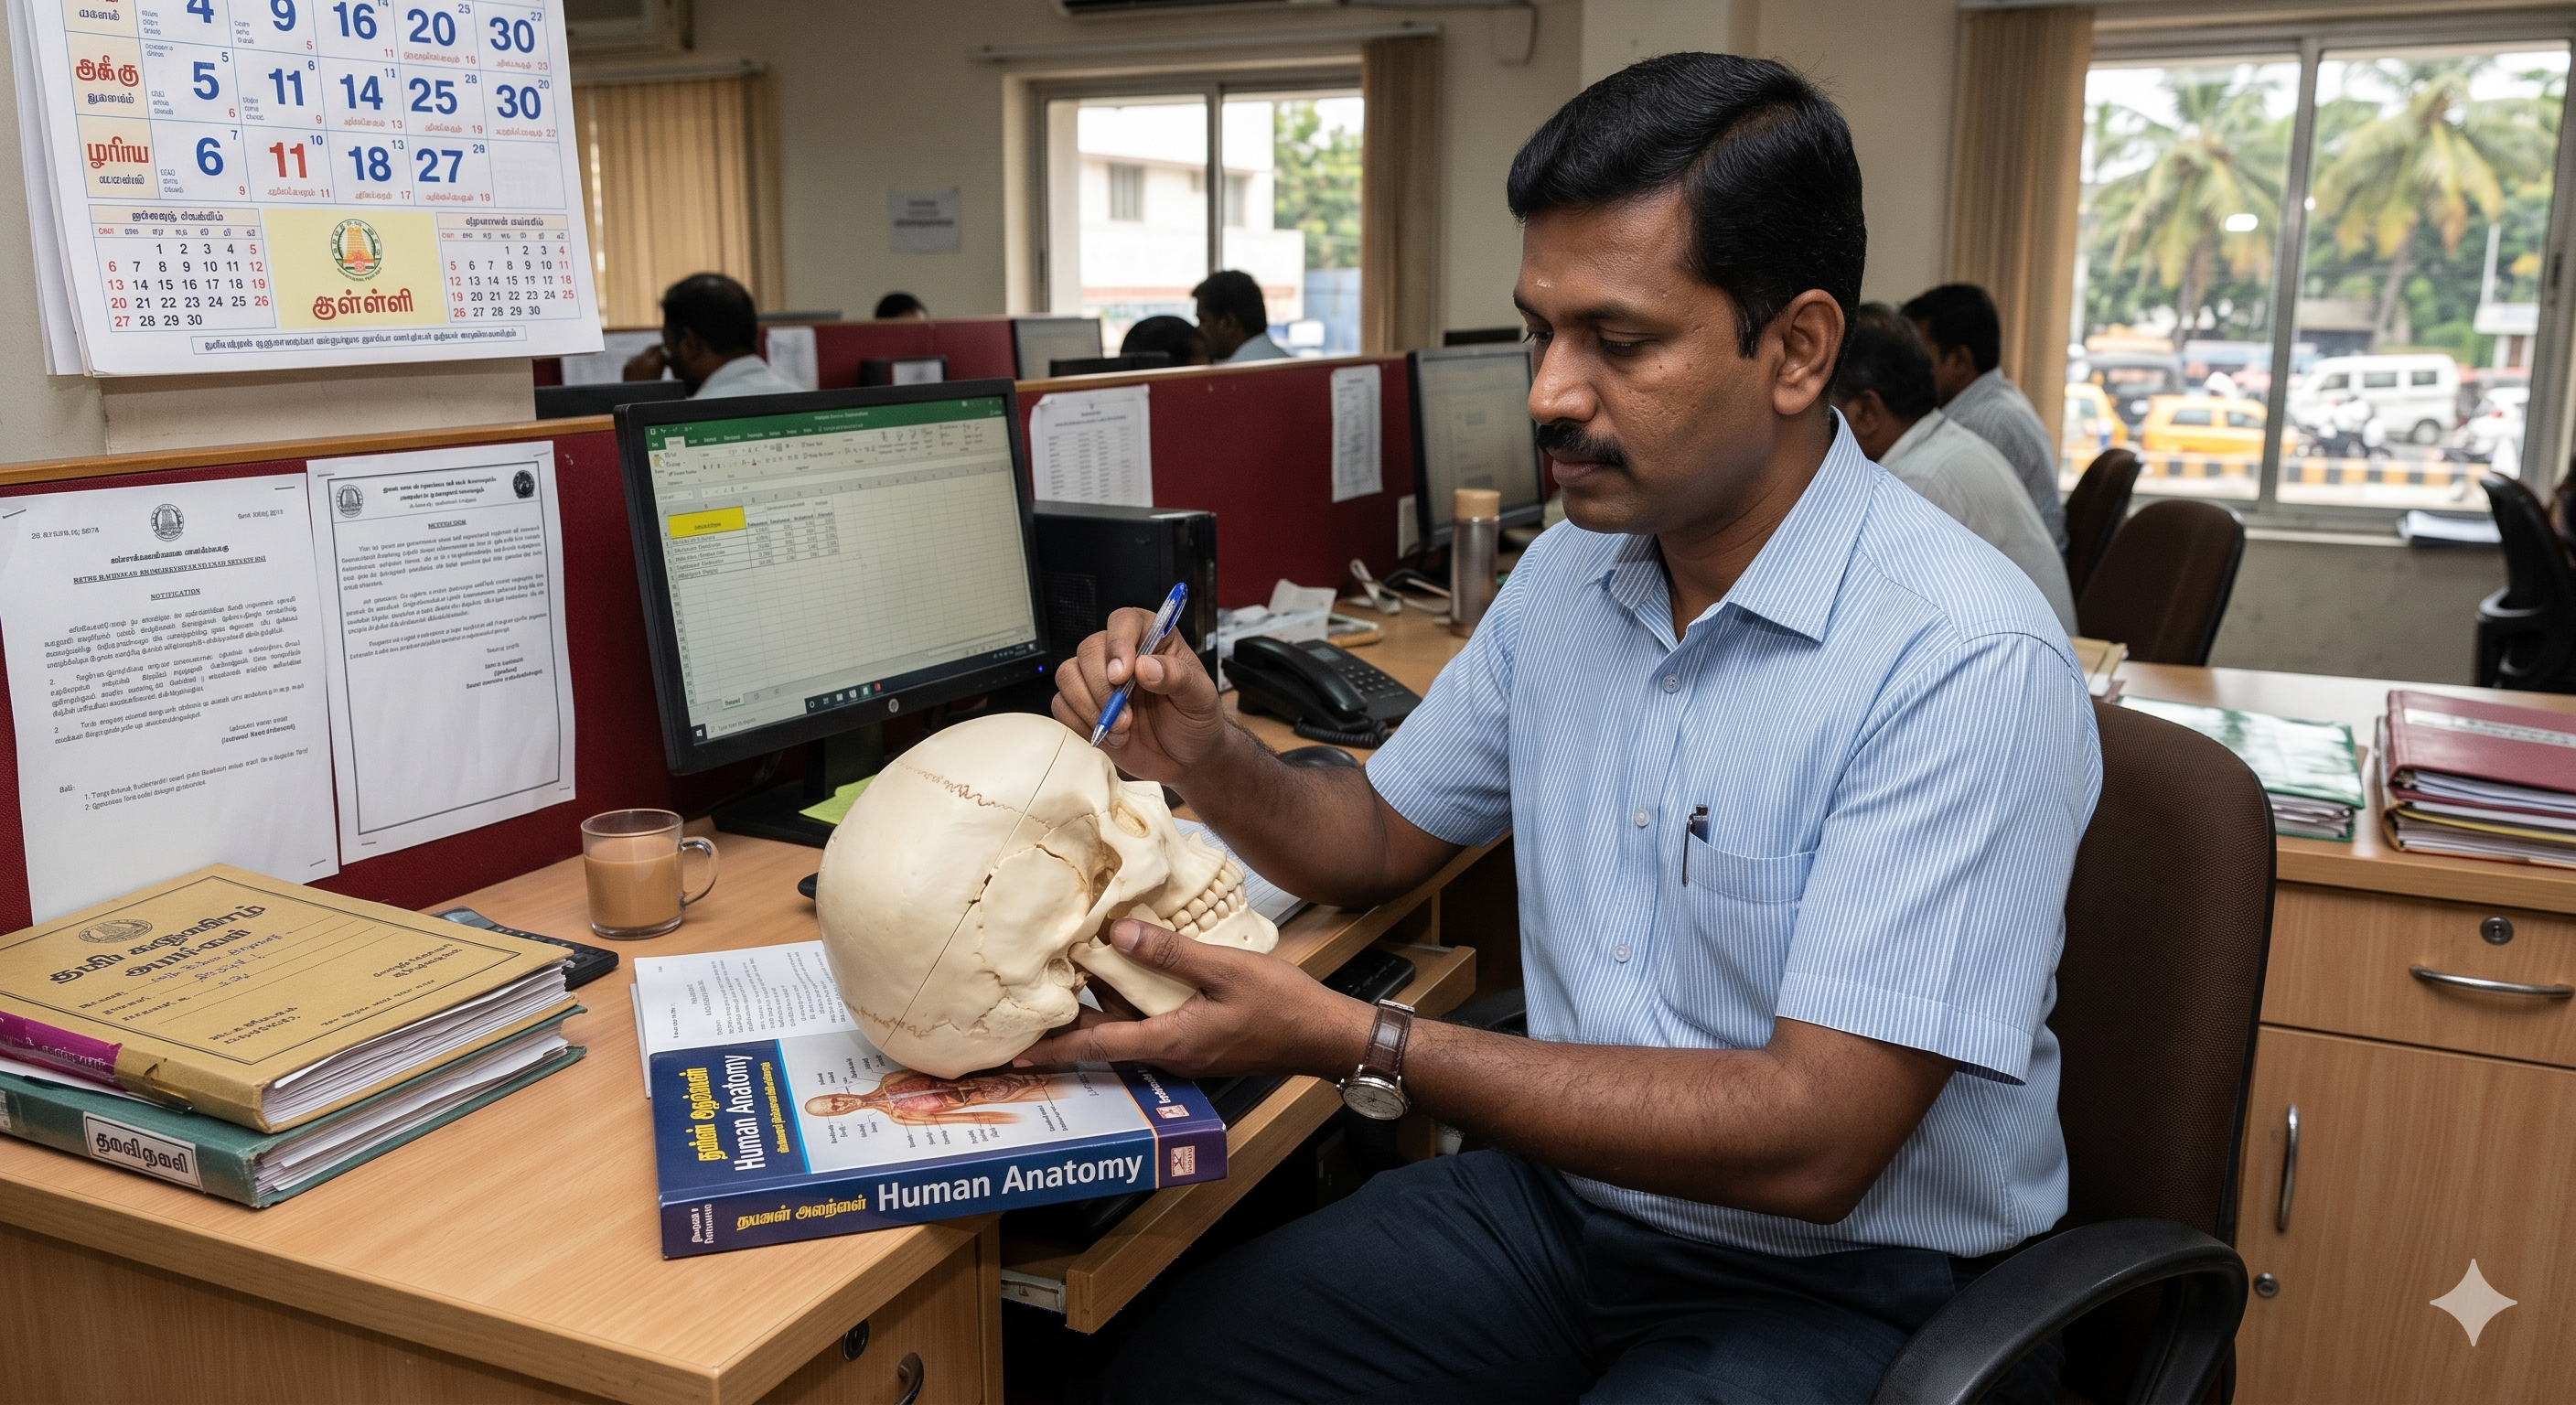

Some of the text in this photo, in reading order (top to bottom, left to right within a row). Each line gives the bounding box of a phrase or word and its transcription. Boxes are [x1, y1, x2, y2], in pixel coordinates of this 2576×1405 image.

[187, 0, 535, 53] 4 9 16 20 30
[307, 41, 312, 49] 5
[384, 48, 393, 57] 11
[466, 56, 476, 64] 16
[222, 52, 229, 62] 5
[308, 60, 315, 70] 8
[538, 80, 549, 89] 20
[194, 61, 542, 120] 5 11 14 25 30
[229, 108, 235, 117] 6
[317, 115, 322, 123] 9
[392, 120, 402, 129] 13
[472, 125, 482, 134] 19
[546, 129, 555, 137] 22
[231, 130, 237, 140] 7
[311, 135, 323, 145] 10
[392, 140, 403, 149] 13
[197, 137, 463, 183] 6 11 18 27
[240, 187, 245, 195] 9
[320, 189, 329, 198] 11
[401, 191, 410, 199] 17
[156, 243, 256, 254] 1 2 3 4 5
[506, 246, 564, 255] 1 2 3 4
[109, 261, 263, 272] 6 7 8 9 10 11 12
[451, 261, 568, 271] 5 6 7 8 9 10 11
[108, 279, 265, 290] 13 14 15 16 17 18 19
[450, 276, 461, 285] 12
[468, 276, 480, 285] 13
[488, 276, 499, 285] 14
[507, 276, 518, 285] 15
[561, 275, 572, 284] 18
[452, 290, 574, 301] 19 20 21 22 23 24 25
[111, 296, 269, 308] 20 21 22 23 24 25 26
[454, 306, 540, 317] 26 27 28 29 30
[114, 315, 202, 327] 27 28 29 30
[151, 588, 201, 600] NOTIFICATION
[722, 1055, 766, 1171] Human Anatomy
[878, 1154, 1143, 1212] Human Anatomy
